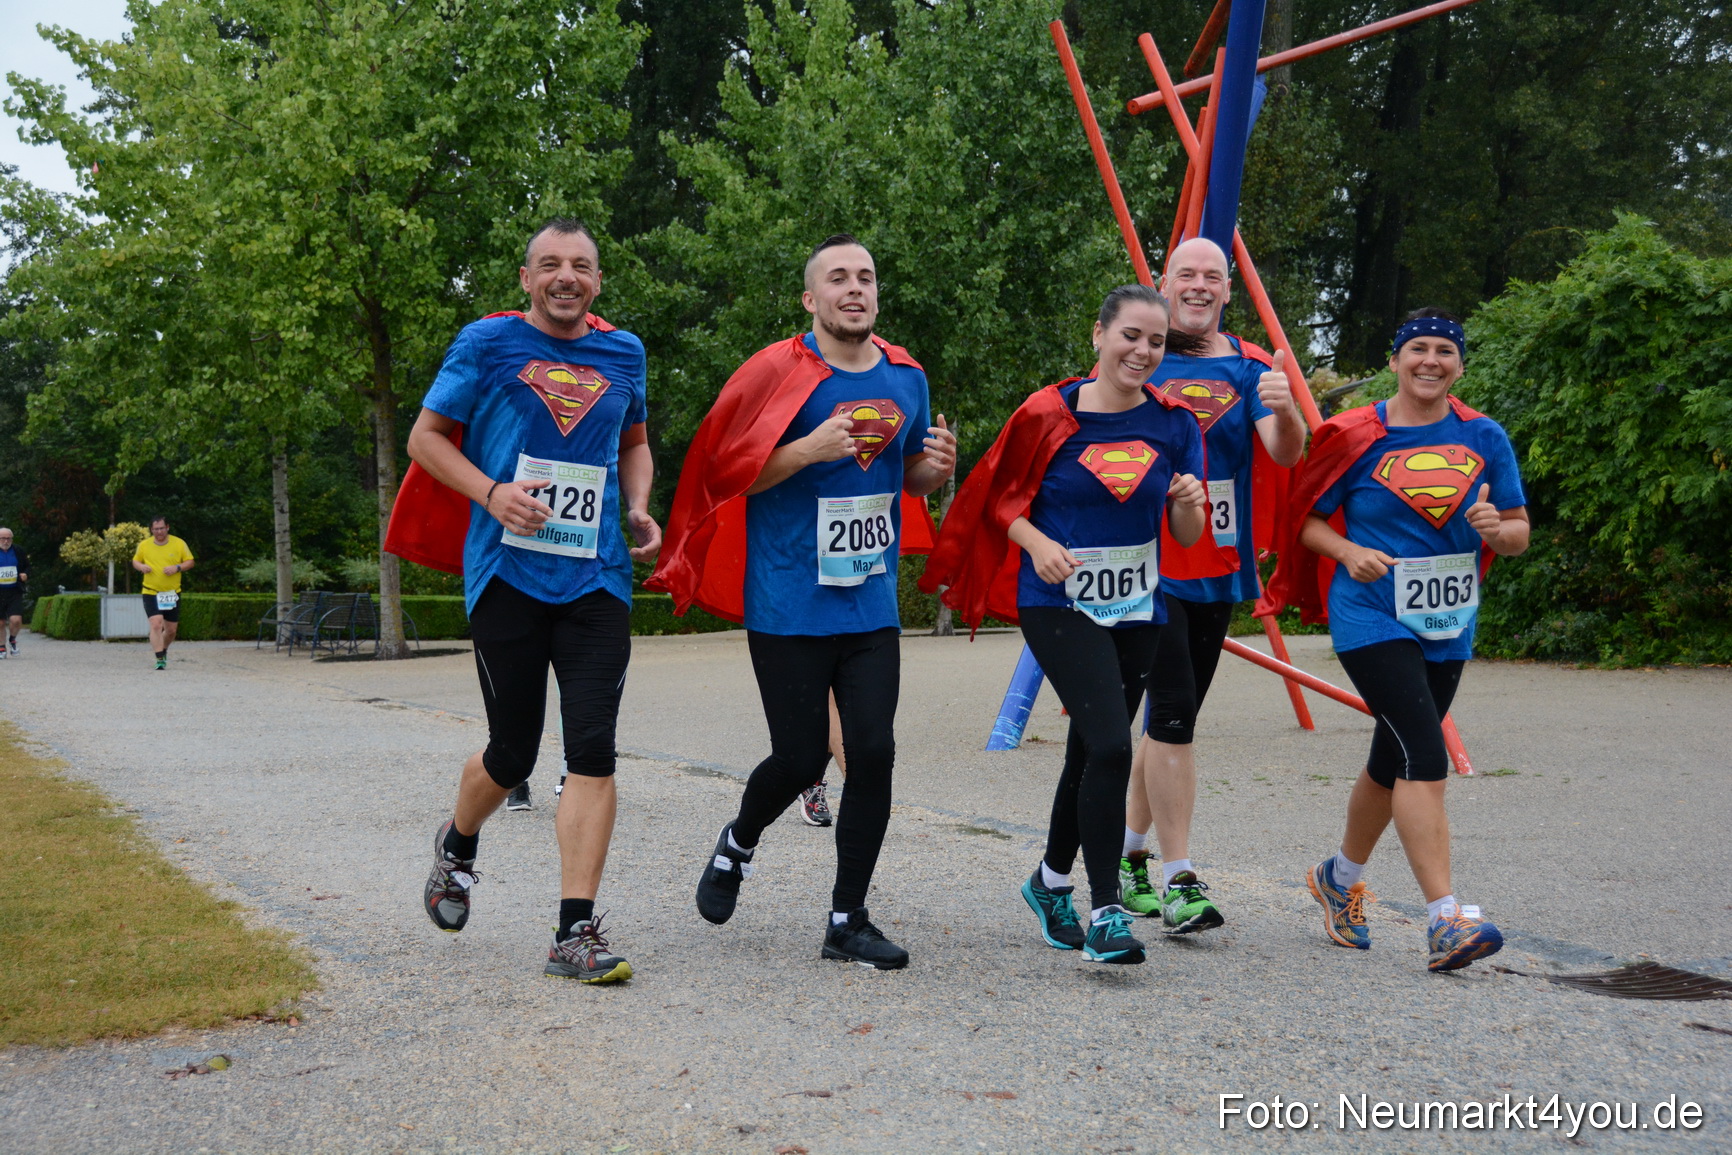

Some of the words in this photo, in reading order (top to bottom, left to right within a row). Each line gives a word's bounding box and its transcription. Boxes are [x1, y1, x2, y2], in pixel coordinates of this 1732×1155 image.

[557, 465, 600, 481] BOCK
[858, 497, 888, 511] BOCK
[527, 527, 584, 547] olfgang
[828, 515, 890, 552] 2088
[853, 560, 875, 573] Max
[1436, 556, 1476, 569] BOCK
[1076, 561, 1149, 602] 2061
[1406, 574, 1474, 610] 2063
[1425, 615, 1459, 630] Gisela
